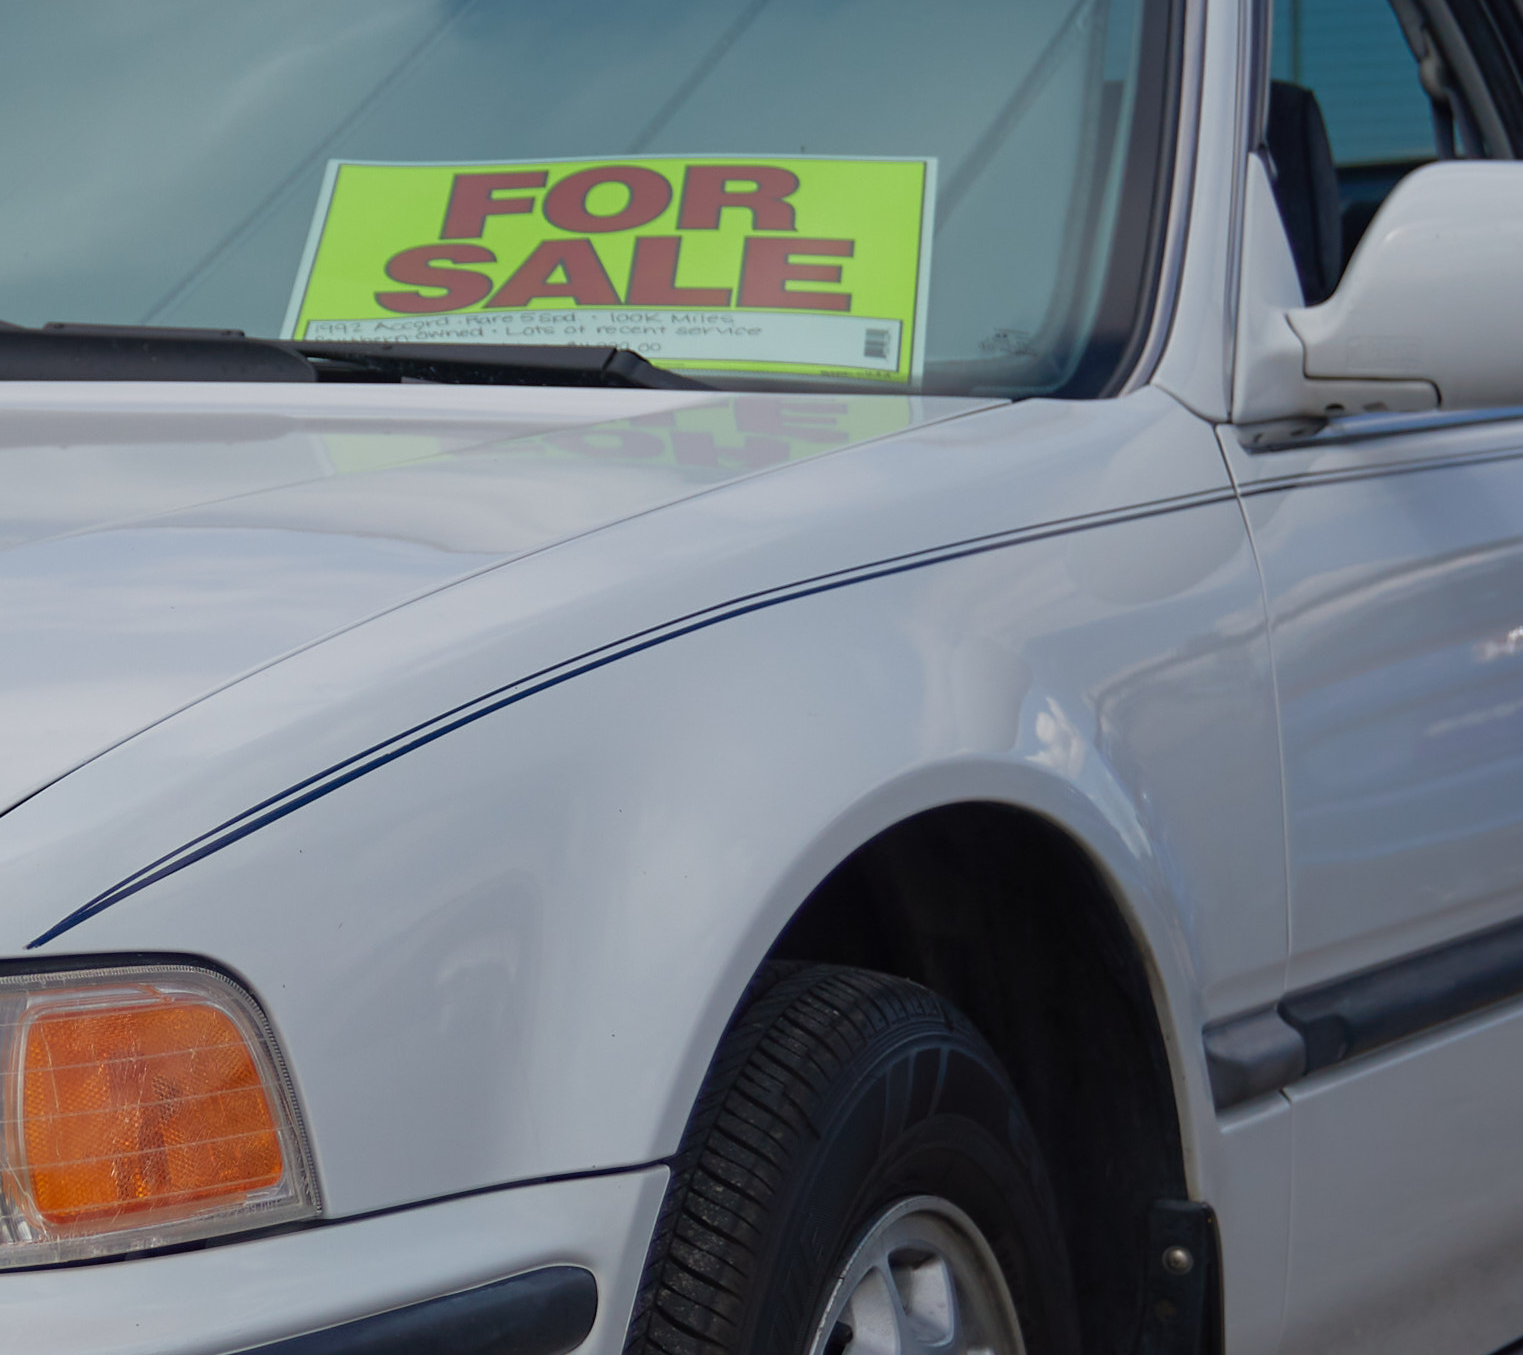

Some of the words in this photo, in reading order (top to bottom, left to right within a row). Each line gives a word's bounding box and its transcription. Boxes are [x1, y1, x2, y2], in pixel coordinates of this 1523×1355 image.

[439, 164, 800, 240] FOR
[373, 235, 856, 313] SALE
[315, 322, 362, 334] 1992
[374, 317, 449, 332] Accord
[465, 315, 513, 325] Rare
[671, 312, 735, 324] Miles
[506, 325, 555, 336] Lots
[596, 326, 666, 335] recent
[675, 326, 763, 336] service
